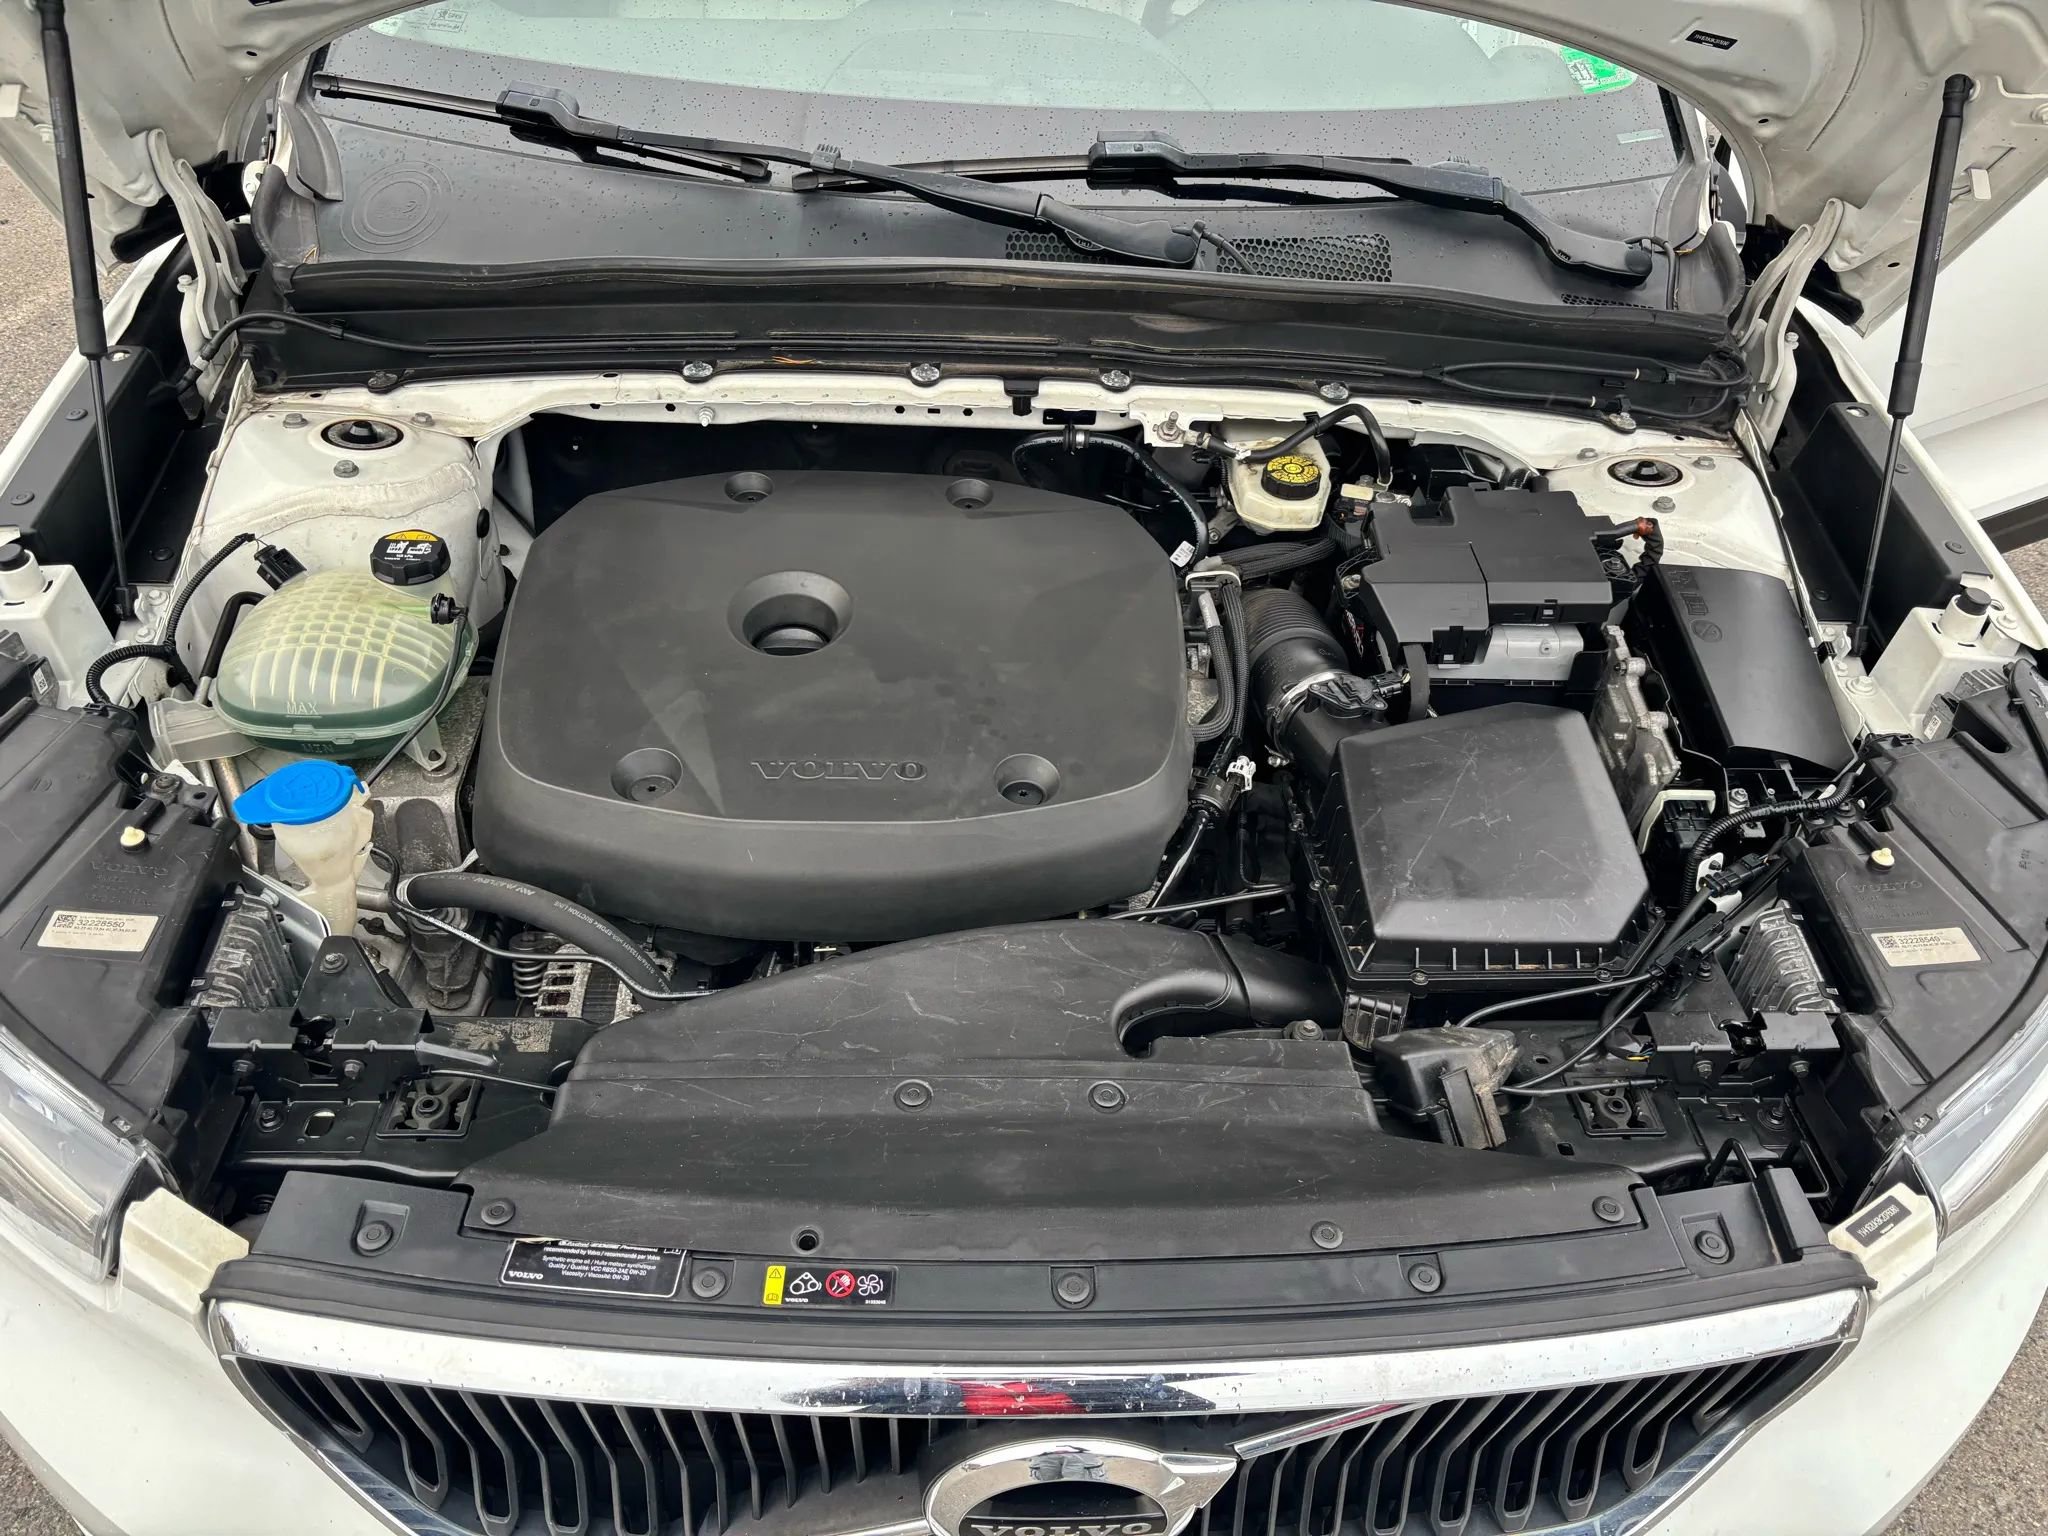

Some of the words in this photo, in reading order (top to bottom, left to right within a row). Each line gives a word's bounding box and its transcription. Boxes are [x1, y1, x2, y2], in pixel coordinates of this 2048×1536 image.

[286, 701, 320, 716] MAX
[750, 760, 928, 781] VOLVO
[548, 1262, 567, 1270] Quality
[508, 1270, 544, 1280] VOLVO
[561, 1269, 584, 1278] Viscosity
[970, 1522, 1153, 1536] VOLVO
